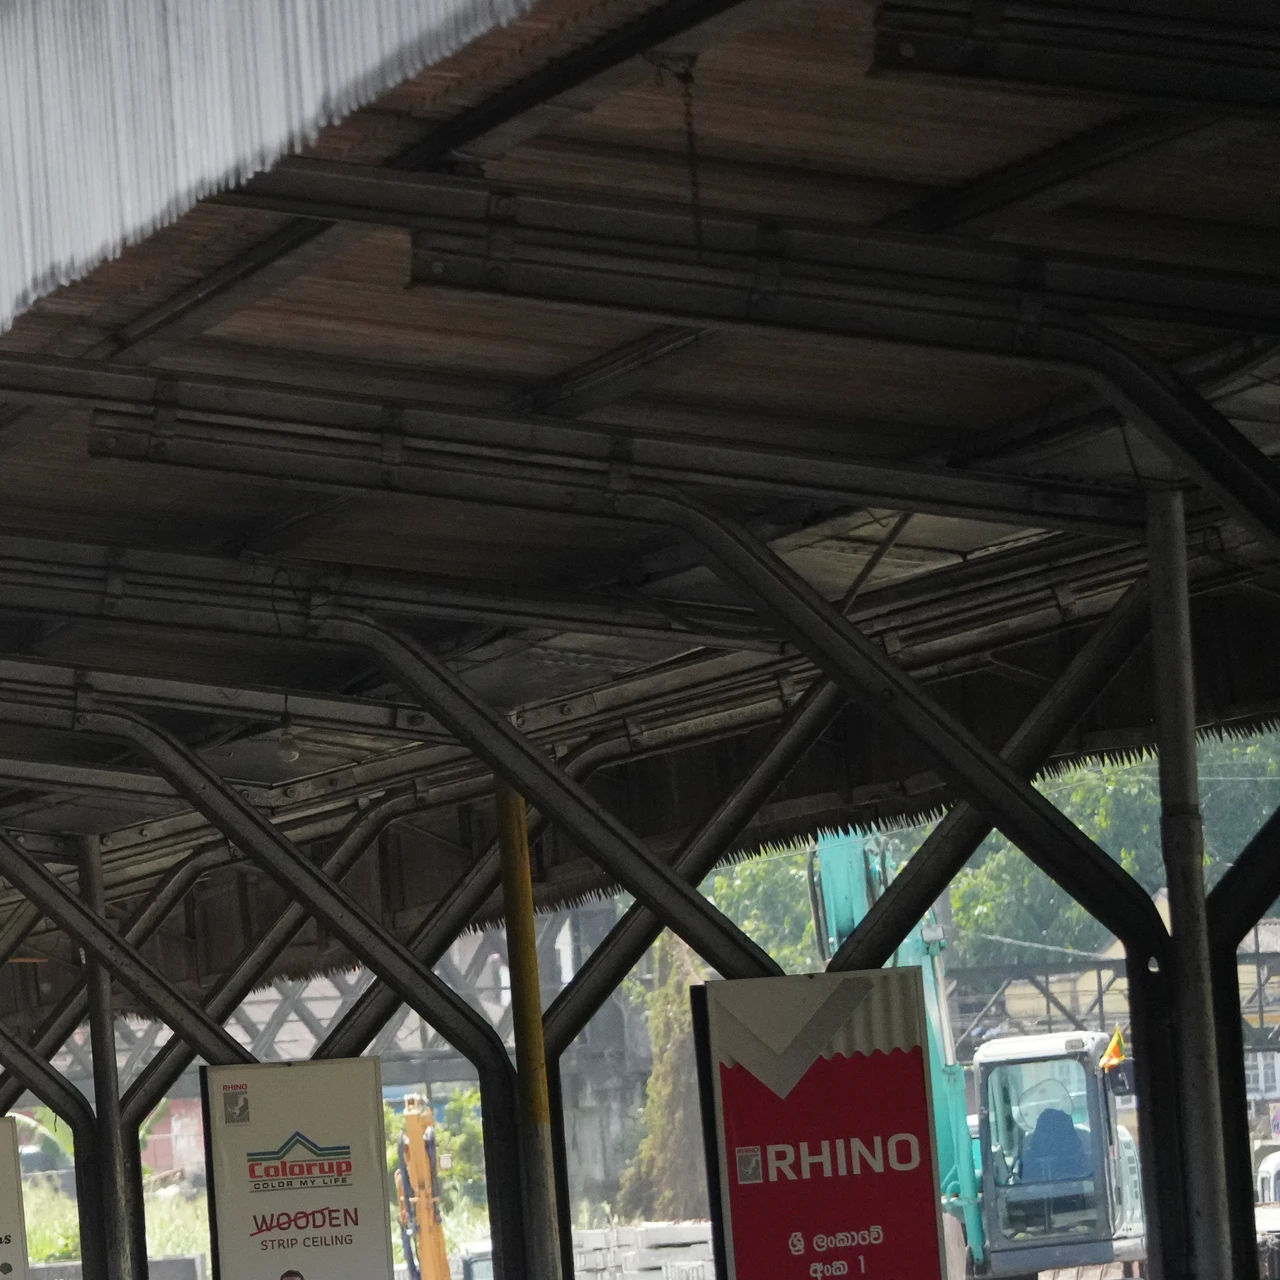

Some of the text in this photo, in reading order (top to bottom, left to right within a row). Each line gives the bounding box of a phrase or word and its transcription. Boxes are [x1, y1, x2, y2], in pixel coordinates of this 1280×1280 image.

[248, 1161, 352, 1178] Colorup
[766, 1133, 920, 1182] RHINO
[254, 1181, 293, 1189] COLOR
[323, 1177, 348, 1185] LIFE
[252, 1207, 359, 1232] WOODEN
[261, 1234, 353, 1251] STRIP CEILING
[813, 1225, 884, 1252] ලංකාවේ
[809, 1255, 865, 1280] අංක 1
